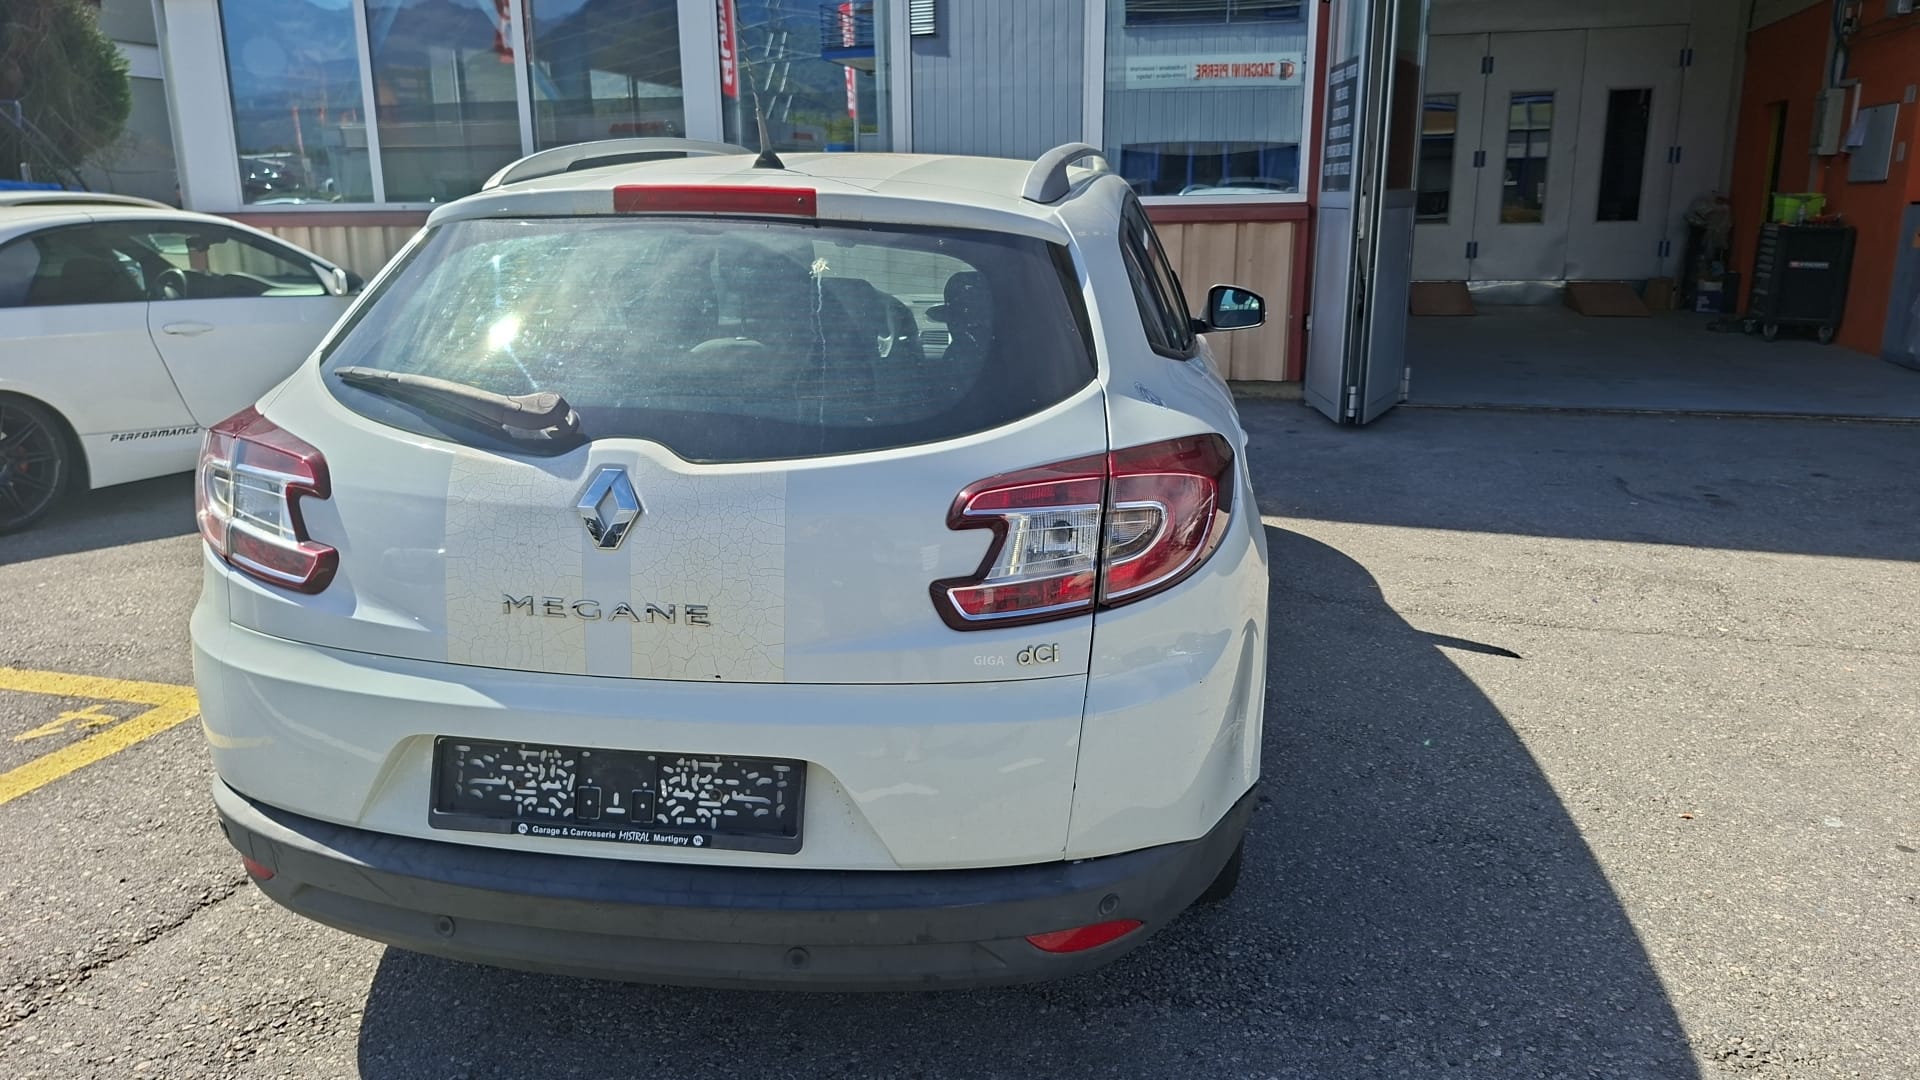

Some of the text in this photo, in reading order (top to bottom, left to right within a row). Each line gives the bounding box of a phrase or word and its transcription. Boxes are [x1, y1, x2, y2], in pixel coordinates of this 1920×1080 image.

[110, 427, 199, 442] PERFORMANCE
[502, 593, 711, 627] MEGANE
[973, 655, 1005, 665] GIGA
[532, 825, 689, 846] Garage & Carrosserie MISTRAL Martigny
